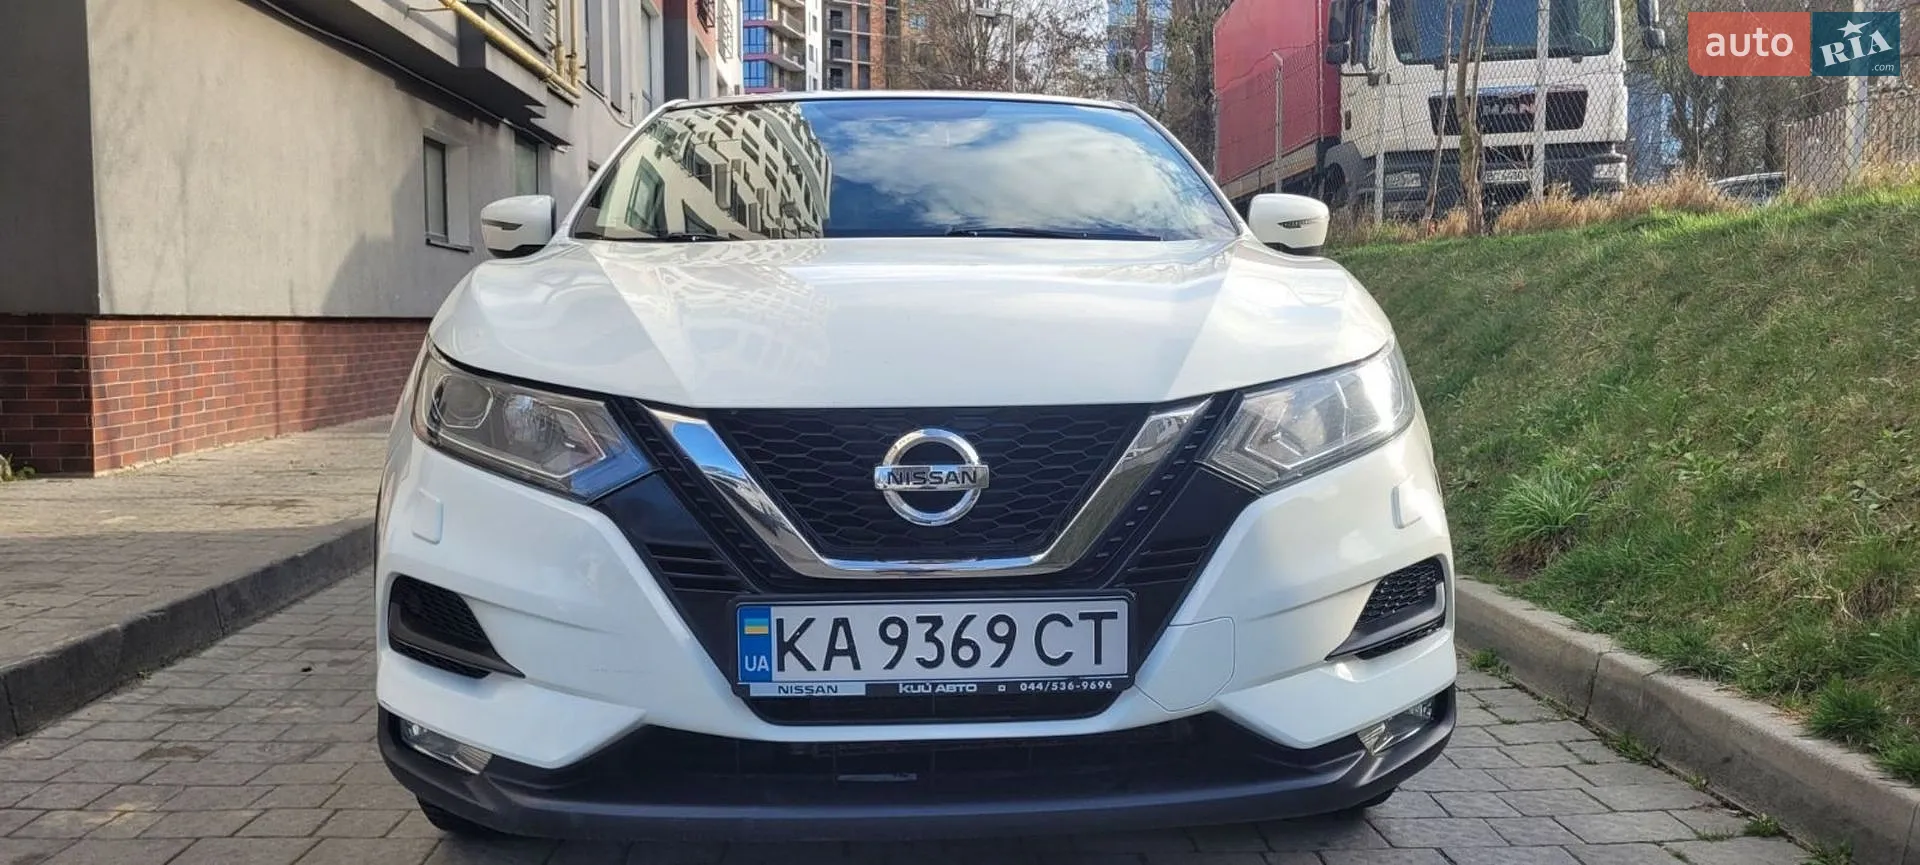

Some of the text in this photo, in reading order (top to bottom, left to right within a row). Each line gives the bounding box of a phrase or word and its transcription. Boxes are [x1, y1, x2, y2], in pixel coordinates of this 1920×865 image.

[1482, 103, 1537, 115] MAN
[887, 470, 977, 485] NISSAN
[775, 611, 1119, 672] KA 9369 CT
[745, 655, 770, 672] UA
[778, 684, 838, 694] NISSAN
[1019, 680, 1113, 692] 044/536-9696
